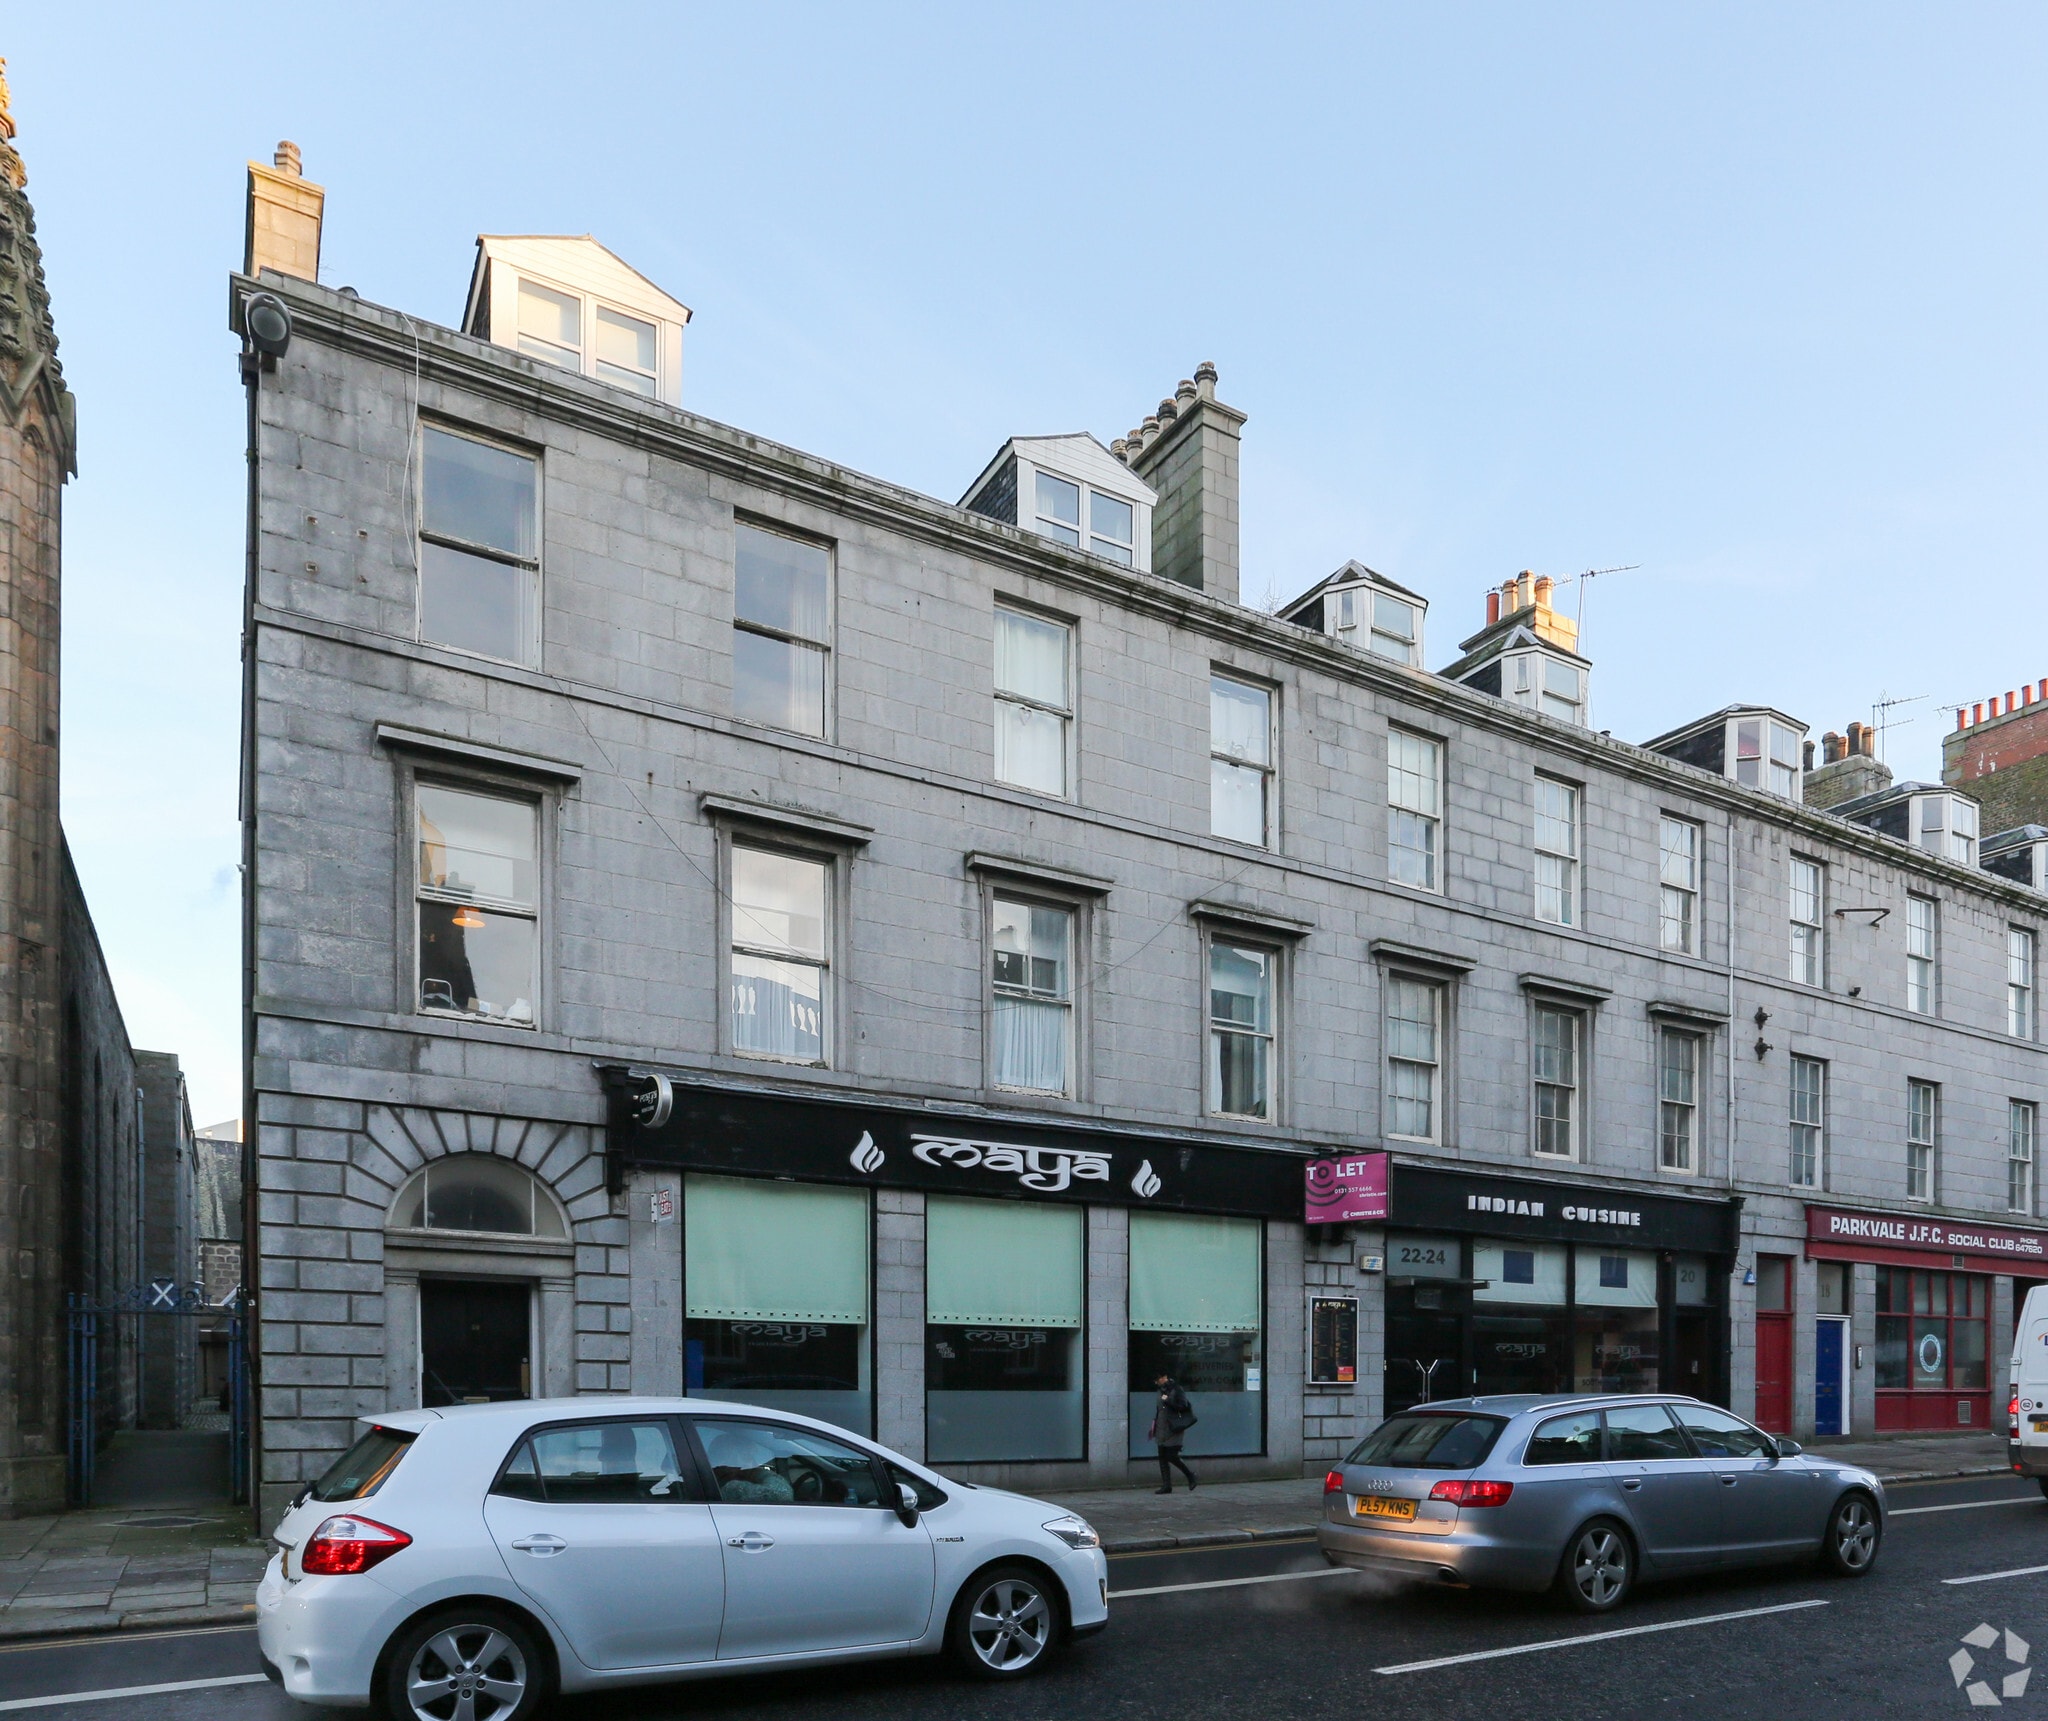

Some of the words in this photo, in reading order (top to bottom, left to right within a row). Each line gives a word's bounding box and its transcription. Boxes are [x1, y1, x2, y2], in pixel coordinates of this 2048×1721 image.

[911, 1134, 1112, 1192] maya
[1336, 1162, 1366, 1177] LET
[1468, 1195, 1544, 1217] INDIAN
[1562, 1206, 1641, 1226] CUISINE
[1830, 1216, 1905, 1240] PARKVALE
[1909, 1225, 1944, 1244] J.F.C.
[1948, 1233, 1986, 1248] SOCIAL
[1988, 1237, 2014, 1251] CLUB
[2020, 1237, 2038, 1245] PHONE
[1401, 1247, 1446, 1264] 22-24
[1681, 1270, 1696, 1283] 20
[1360, 1500, 1387, 1513] PL57
[1388, 1503, 1410, 1515] KNS
